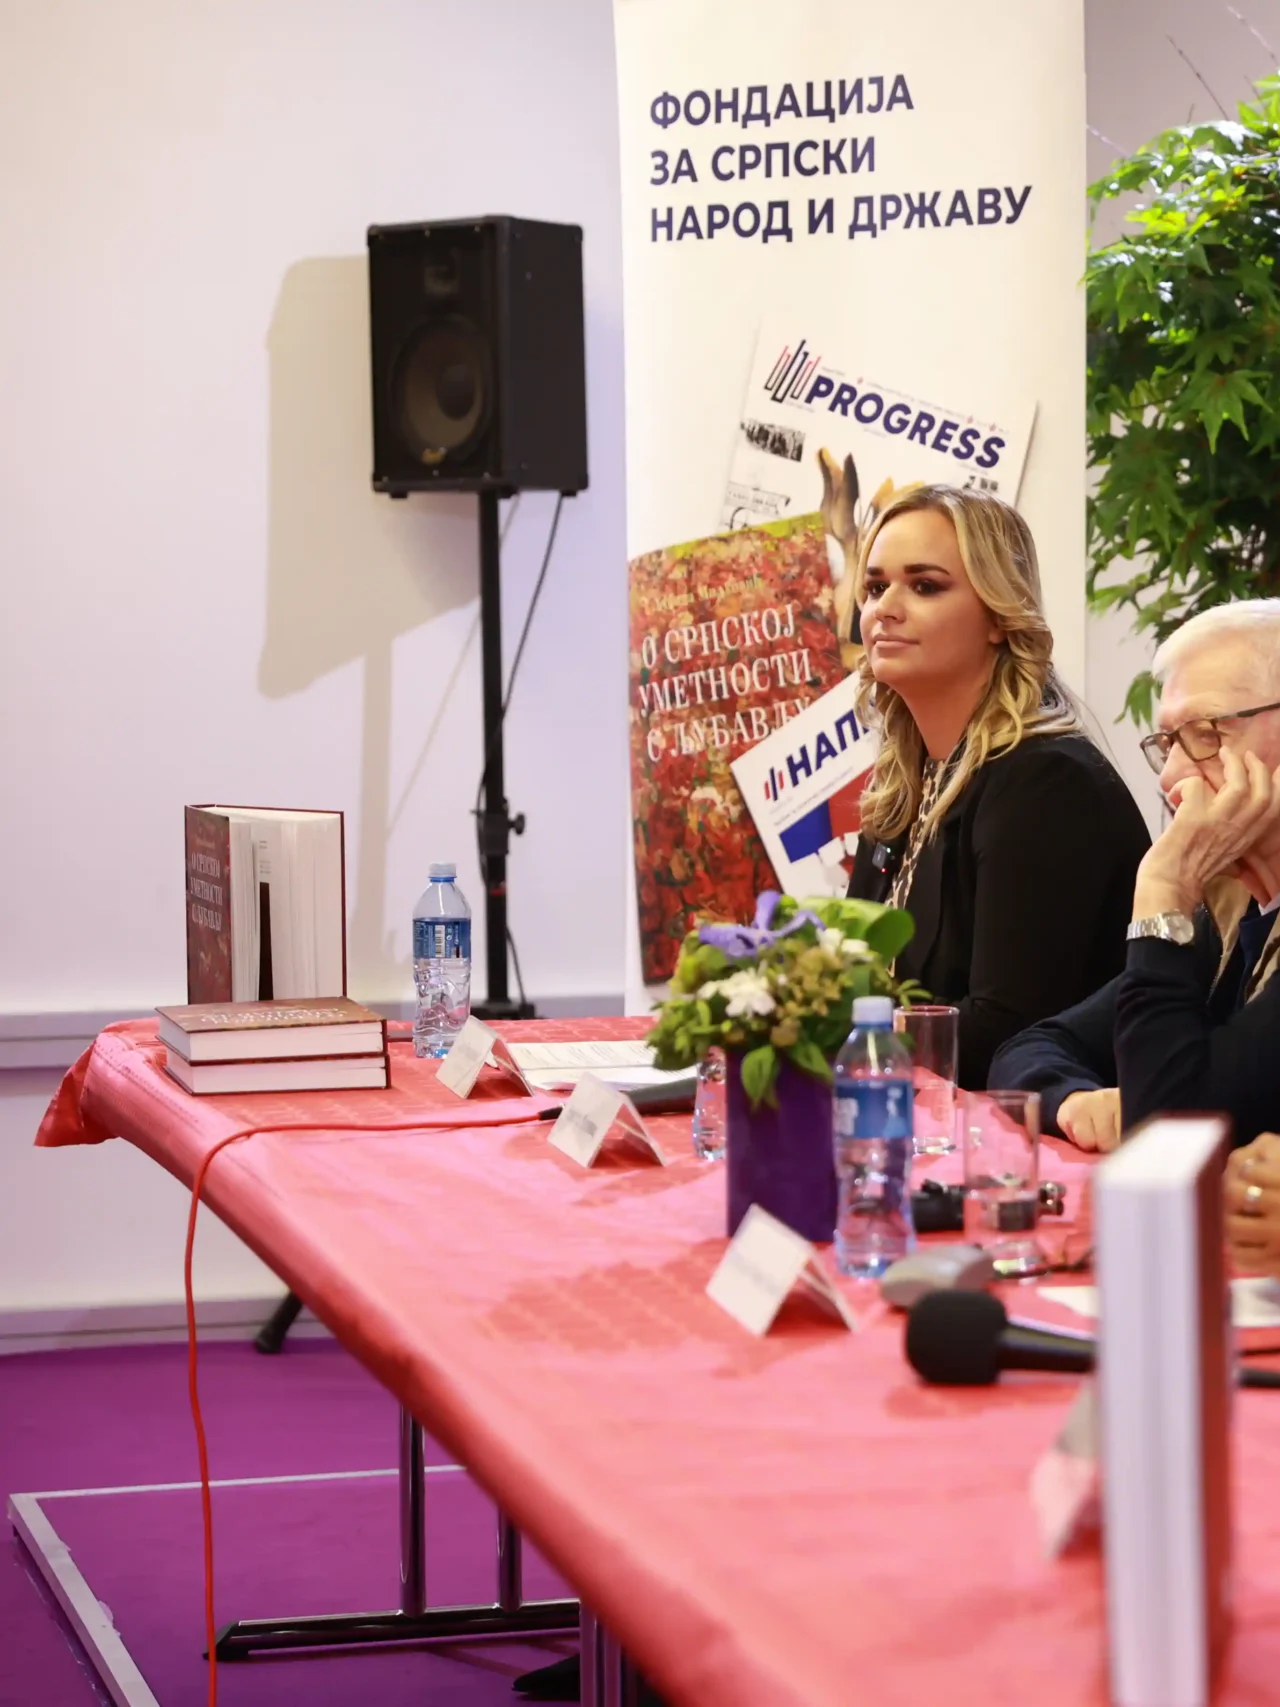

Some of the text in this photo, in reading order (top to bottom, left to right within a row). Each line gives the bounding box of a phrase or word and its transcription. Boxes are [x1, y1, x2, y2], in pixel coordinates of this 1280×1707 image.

[650, 74, 914, 129] ФОНДАЦИЈА
[650, 136, 876, 186] ЗА СРПСКИ
[650, 185, 1033, 243] НАРОД И ДРЖАВУ
[804, 374, 1006, 469] PROGRESS
[642, 603, 797, 669] О СРПСКОЈ
[639, 648, 813, 718] УМЕТНОСТИ
[647, 728, 662, 762] С
[786, 708, 869, 788] НАП
